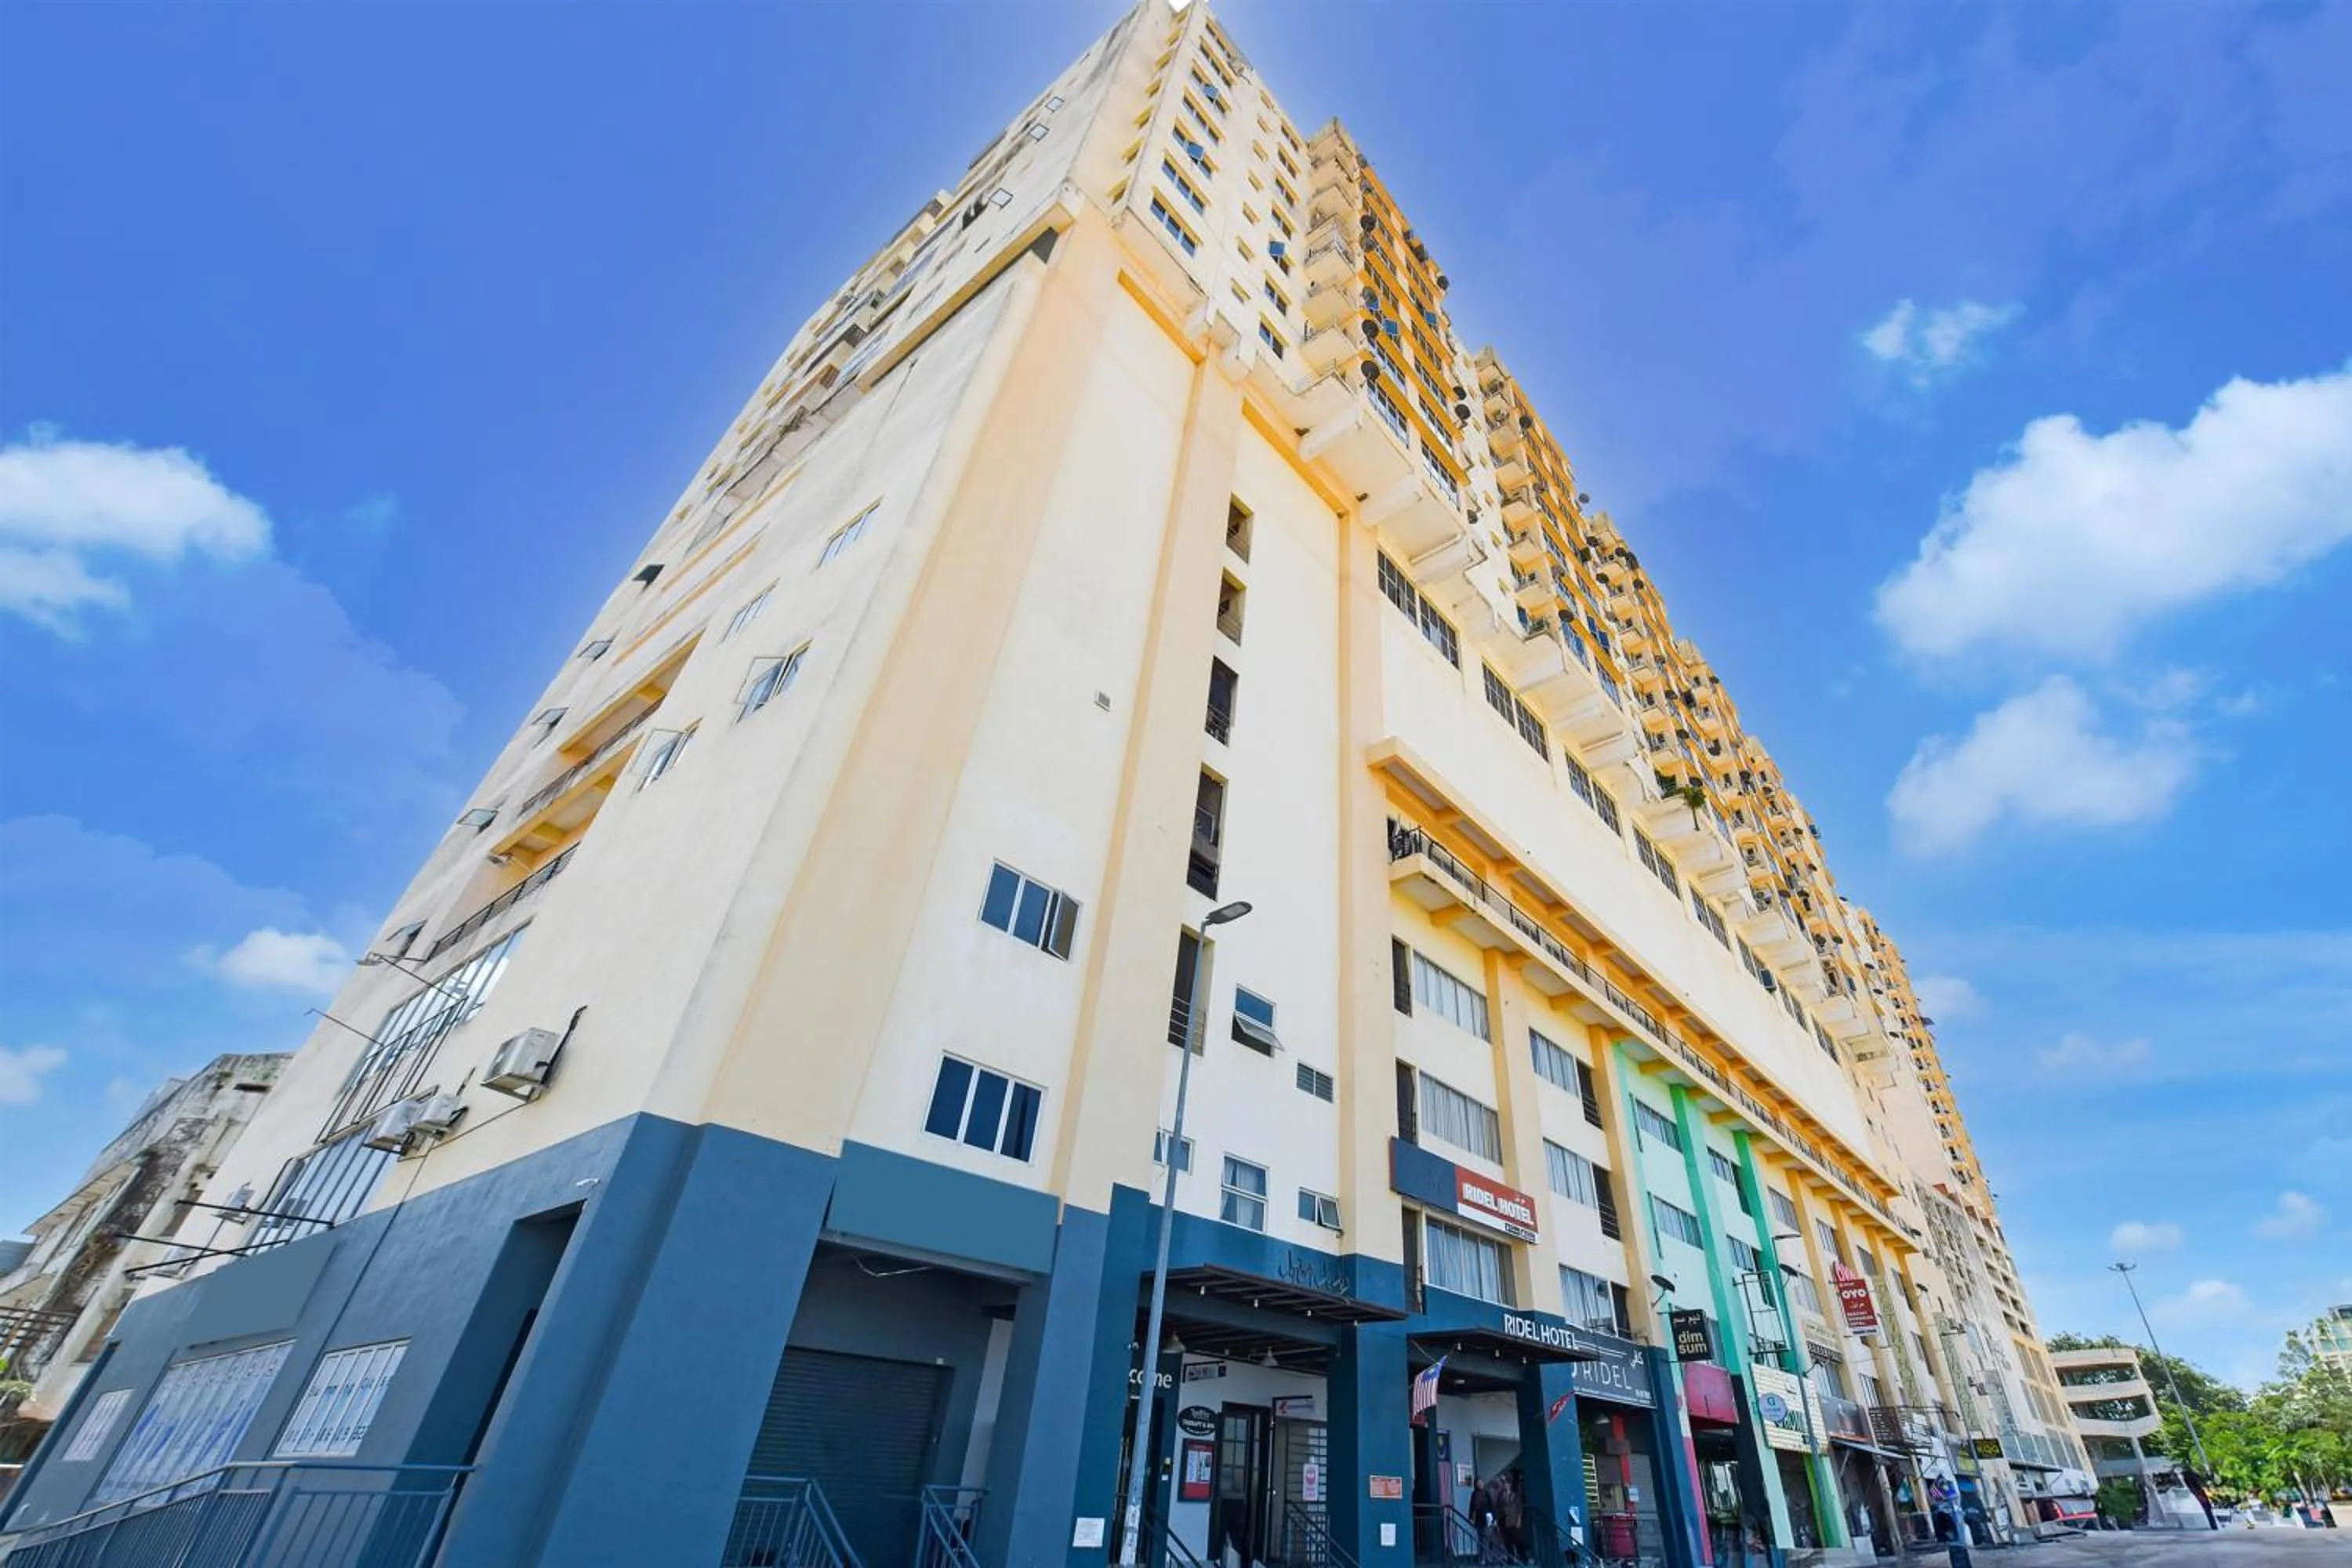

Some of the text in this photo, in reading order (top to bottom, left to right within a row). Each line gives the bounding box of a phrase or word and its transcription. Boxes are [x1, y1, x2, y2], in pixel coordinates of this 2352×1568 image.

[1462, 1182, 1534, 1225] RIDEL HOTEL
[1842, 1288, 1866, 1299] OYO
[1504, 1314, 1579, 1350] RIDEL HOTEL
[1679, 1330, 1704, 1343] dim
[1679, 1343, 1708, 1354] sum
[1583, 1360, 1632, 1390] RIDEL
